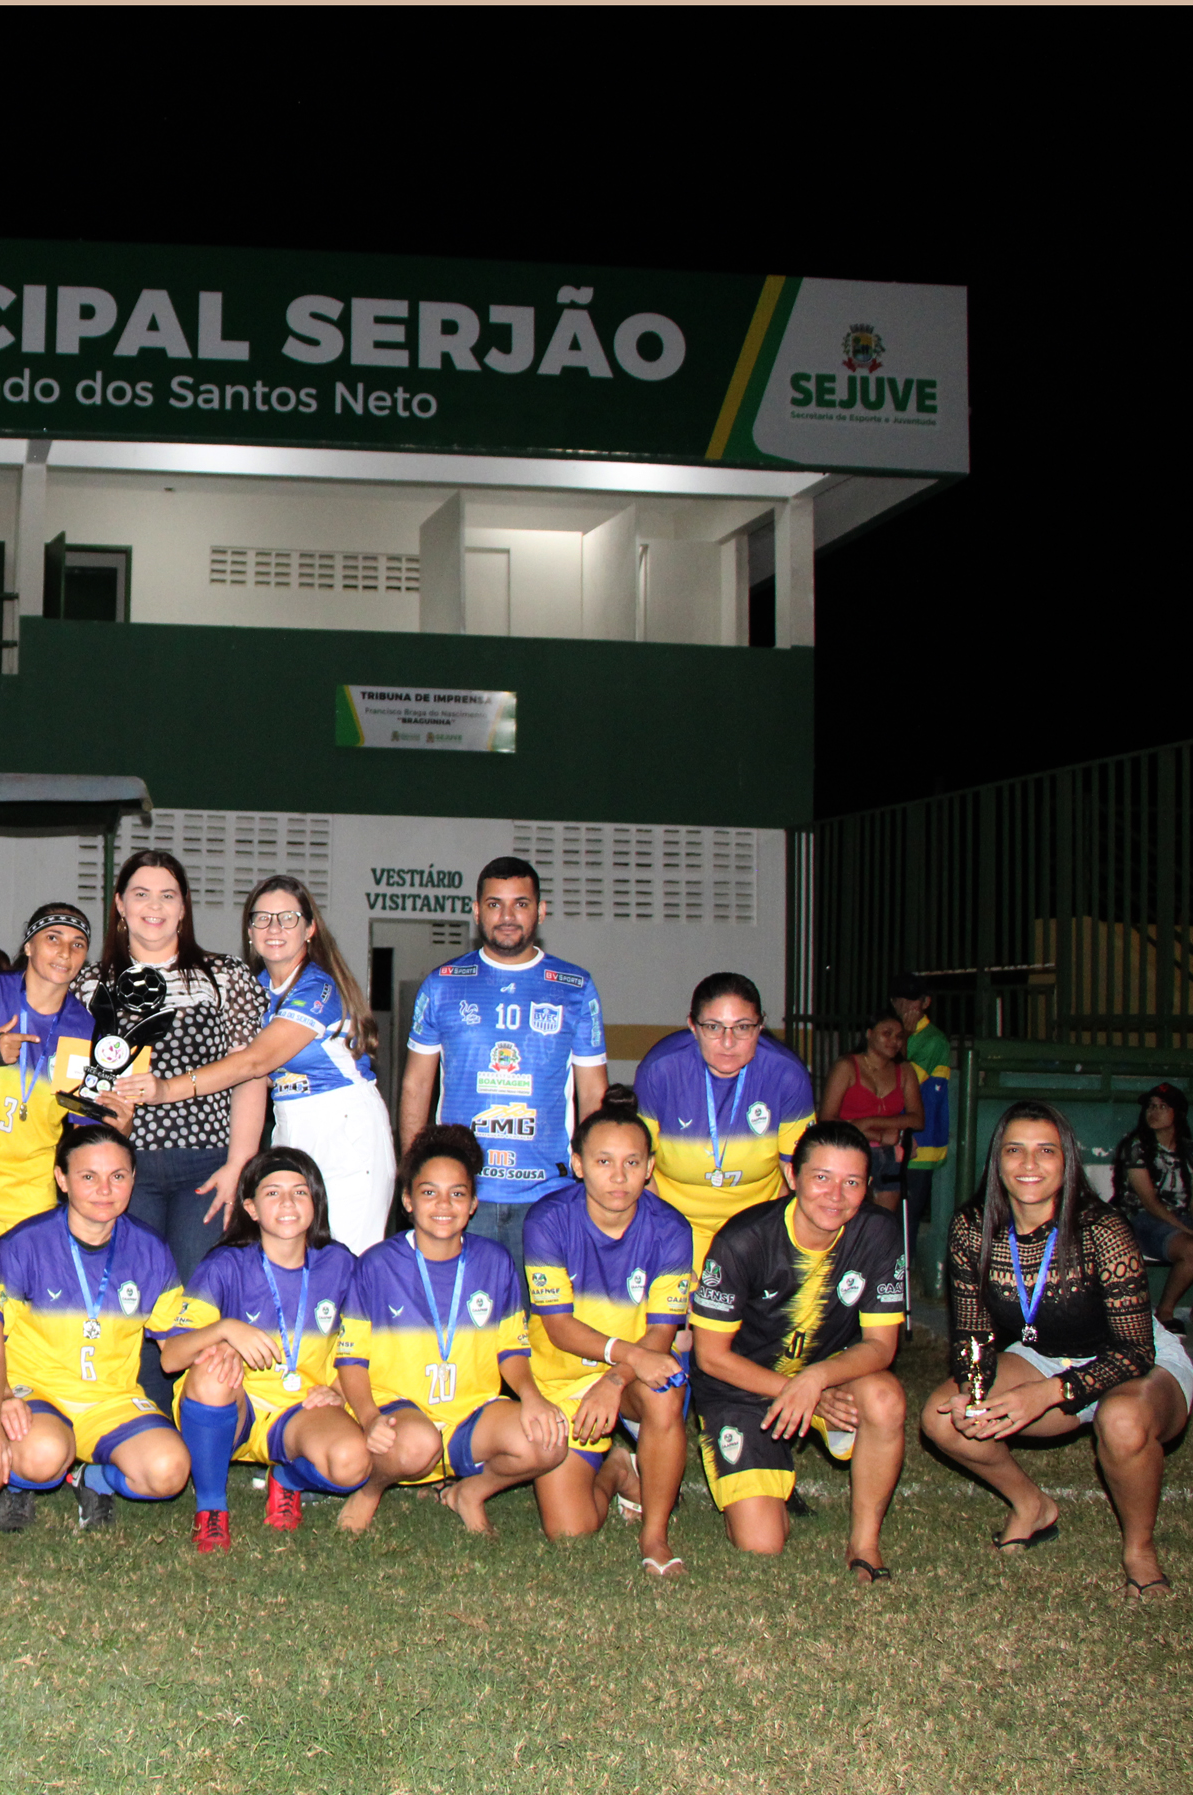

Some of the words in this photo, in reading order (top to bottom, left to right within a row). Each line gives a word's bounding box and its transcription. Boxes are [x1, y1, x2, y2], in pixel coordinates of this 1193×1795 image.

[281, 285, 686, 382] SERJÃO
[76, 371, 154, 407] dos
[168, 376, 318, 414] Santos
[335, 382, 438, 419] Neto
[789, 372, 938, 414] SEJUVE
[790, 410, 834, 421] Secretaria
[835, 413, 847, 421] de
[849, 414, 882, 423] Esporte
[893, 416, 937, 426] Juventude
[360, 691, 411, 701] TRIBUNA
[415, 693, 430, 702] DE
[433, 694, 492, 704] IMPRENSA
[365, 707, 402, 715] Francisco
[404, 708, 426, 717] Braga
[370, 863, 463, 889] VESTIÁRIO
[365, 892, 473, 914] VISITANTE
[440, 966, 453, 975] BV
[453, 966, 477, 975] SPORTS
[546, 971, 558, 981] BV
[558, 974, 583, 986] SPORTS
[495, 1003, 521, 1030] 10
[481, 1167, 505, 1178] COS
[508, 1168, 545, 1180] SOUSA
[697, 1286, 736, 1305] AFNSF
[80, 1345, 98, 1381] 6
[424, 1362, 457, 1405] 20
